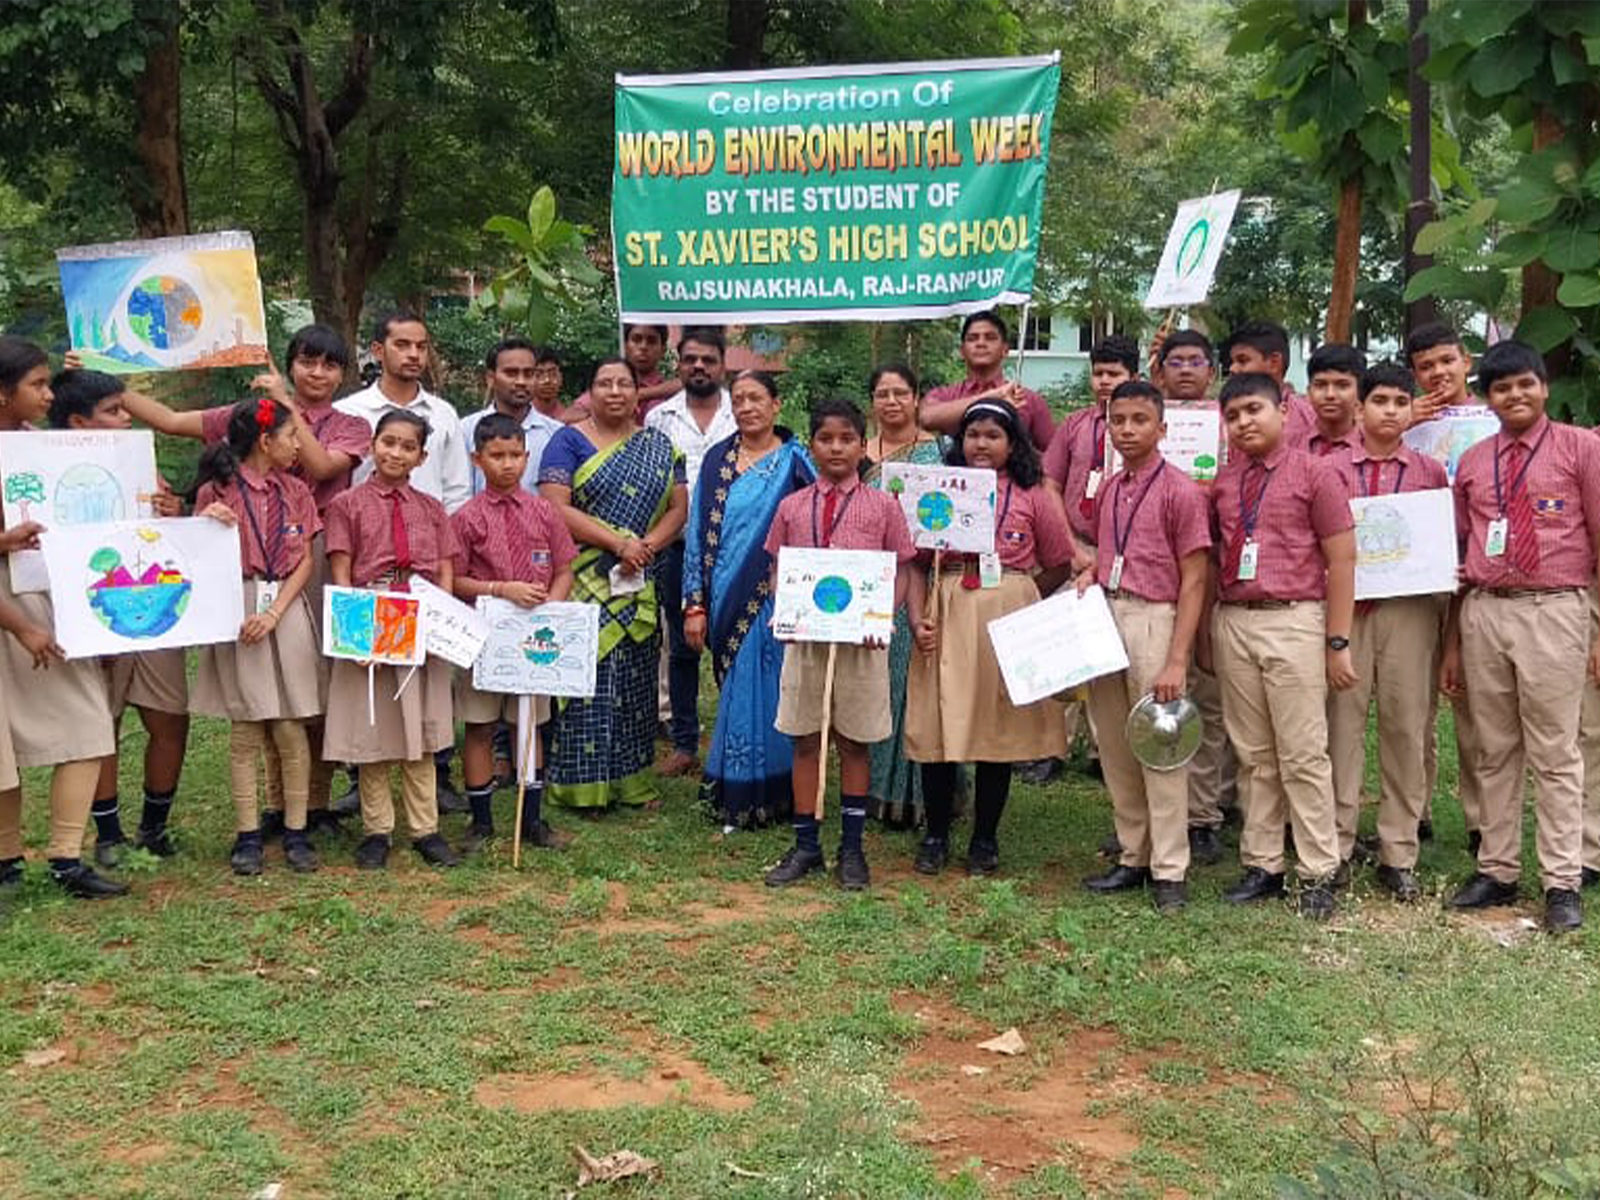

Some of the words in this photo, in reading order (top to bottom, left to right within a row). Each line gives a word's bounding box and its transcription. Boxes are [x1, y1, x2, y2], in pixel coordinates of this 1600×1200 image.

[708, 85, 900, 115] Celebration
[912, 80, 955, 106] Of
[618, 128, 716, 179] WORLD
[724, 119, 961, 177] ENVIRONMENTAL
[706, 189, 737, 216] BY
[745, 188, 796, 213] THE
[802, 183, 919, 211] STUDENT
[928, 182, 960, 207] OF
[625, 231, 668, 267] ST.
[828, 224, 908, 262] HIGH
[918, 215, 1029, 259] SCHOOL
[658, 276, 855, 301] RAJSUNAKHALA,
[862, 267, 1006, 295] RAJ-RANPUR
